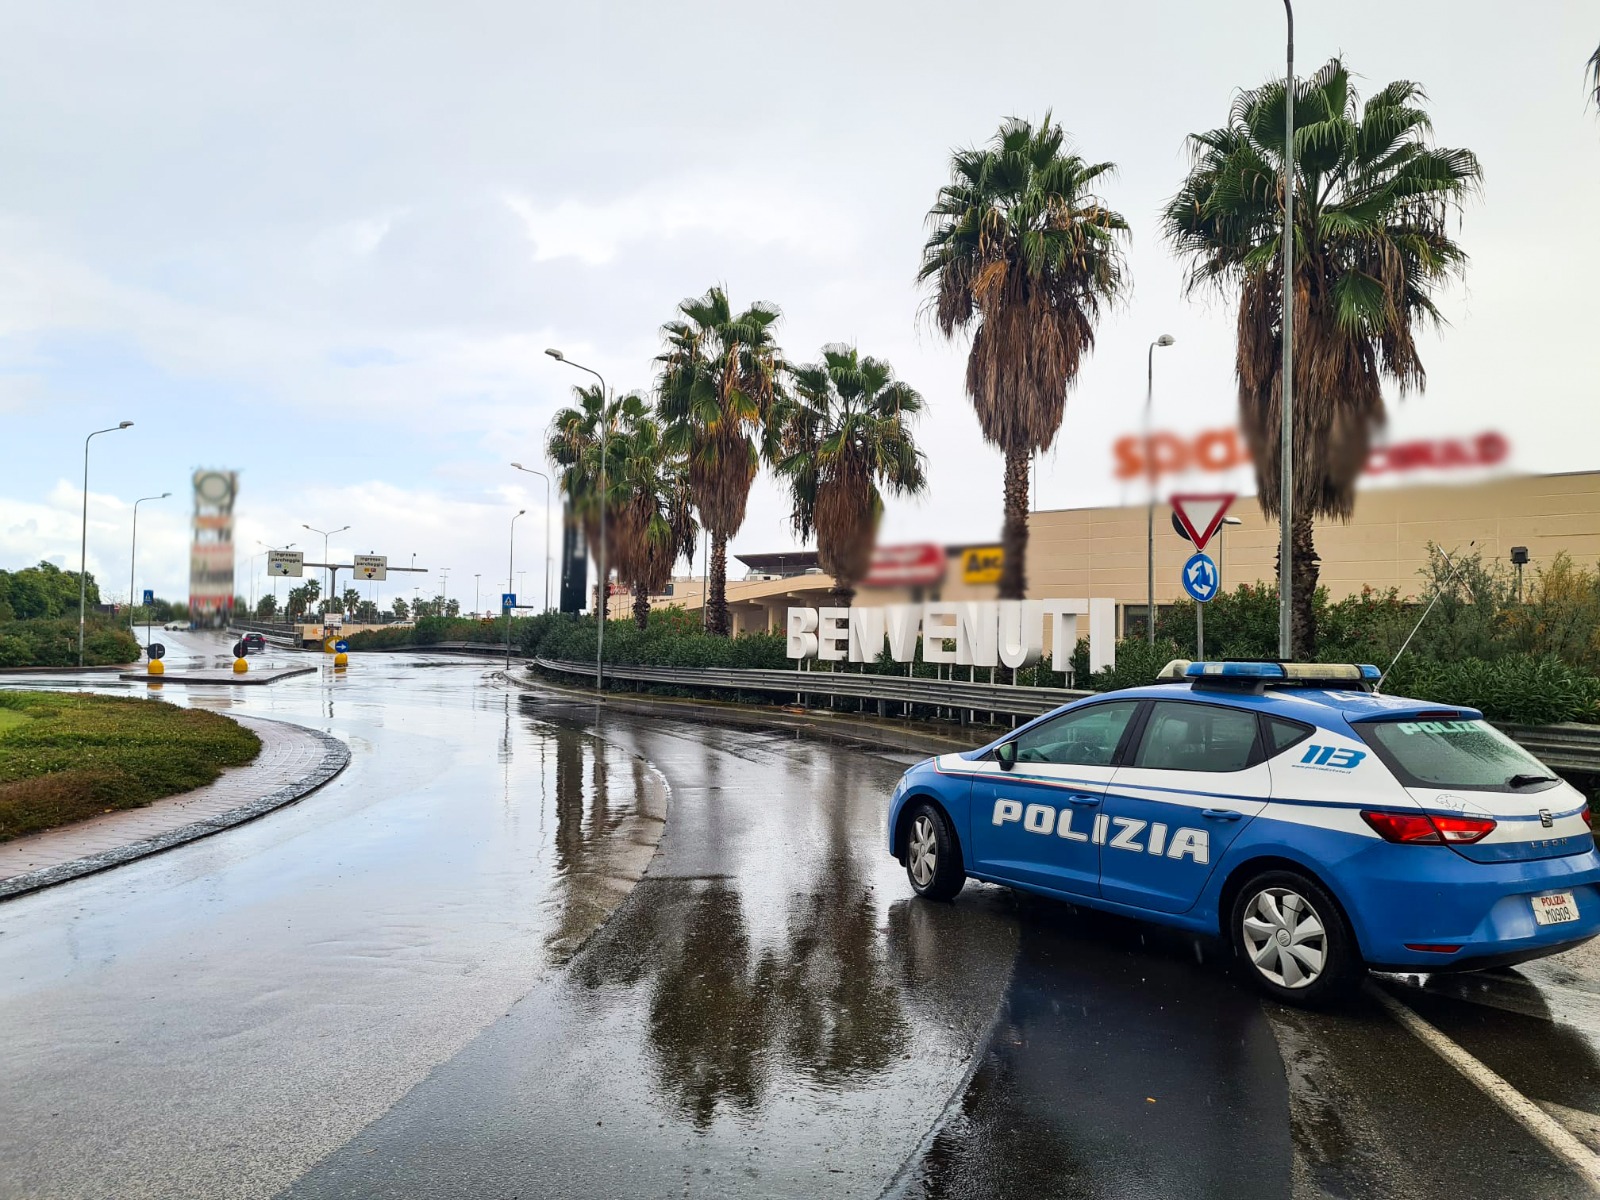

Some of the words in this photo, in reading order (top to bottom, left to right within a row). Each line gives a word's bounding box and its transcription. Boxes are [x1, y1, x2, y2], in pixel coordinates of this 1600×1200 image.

[787, 598, 1115, 674] BENVENUTI
[1300, 744, 1367, 769] 113
[992, 798, 1209, 864] POLIZIA
[1531, 838, 1567, 849] LEON
[1541, 895, 1567, 907] POLIZIA
[1545, 906, 1571, 923] M0909
